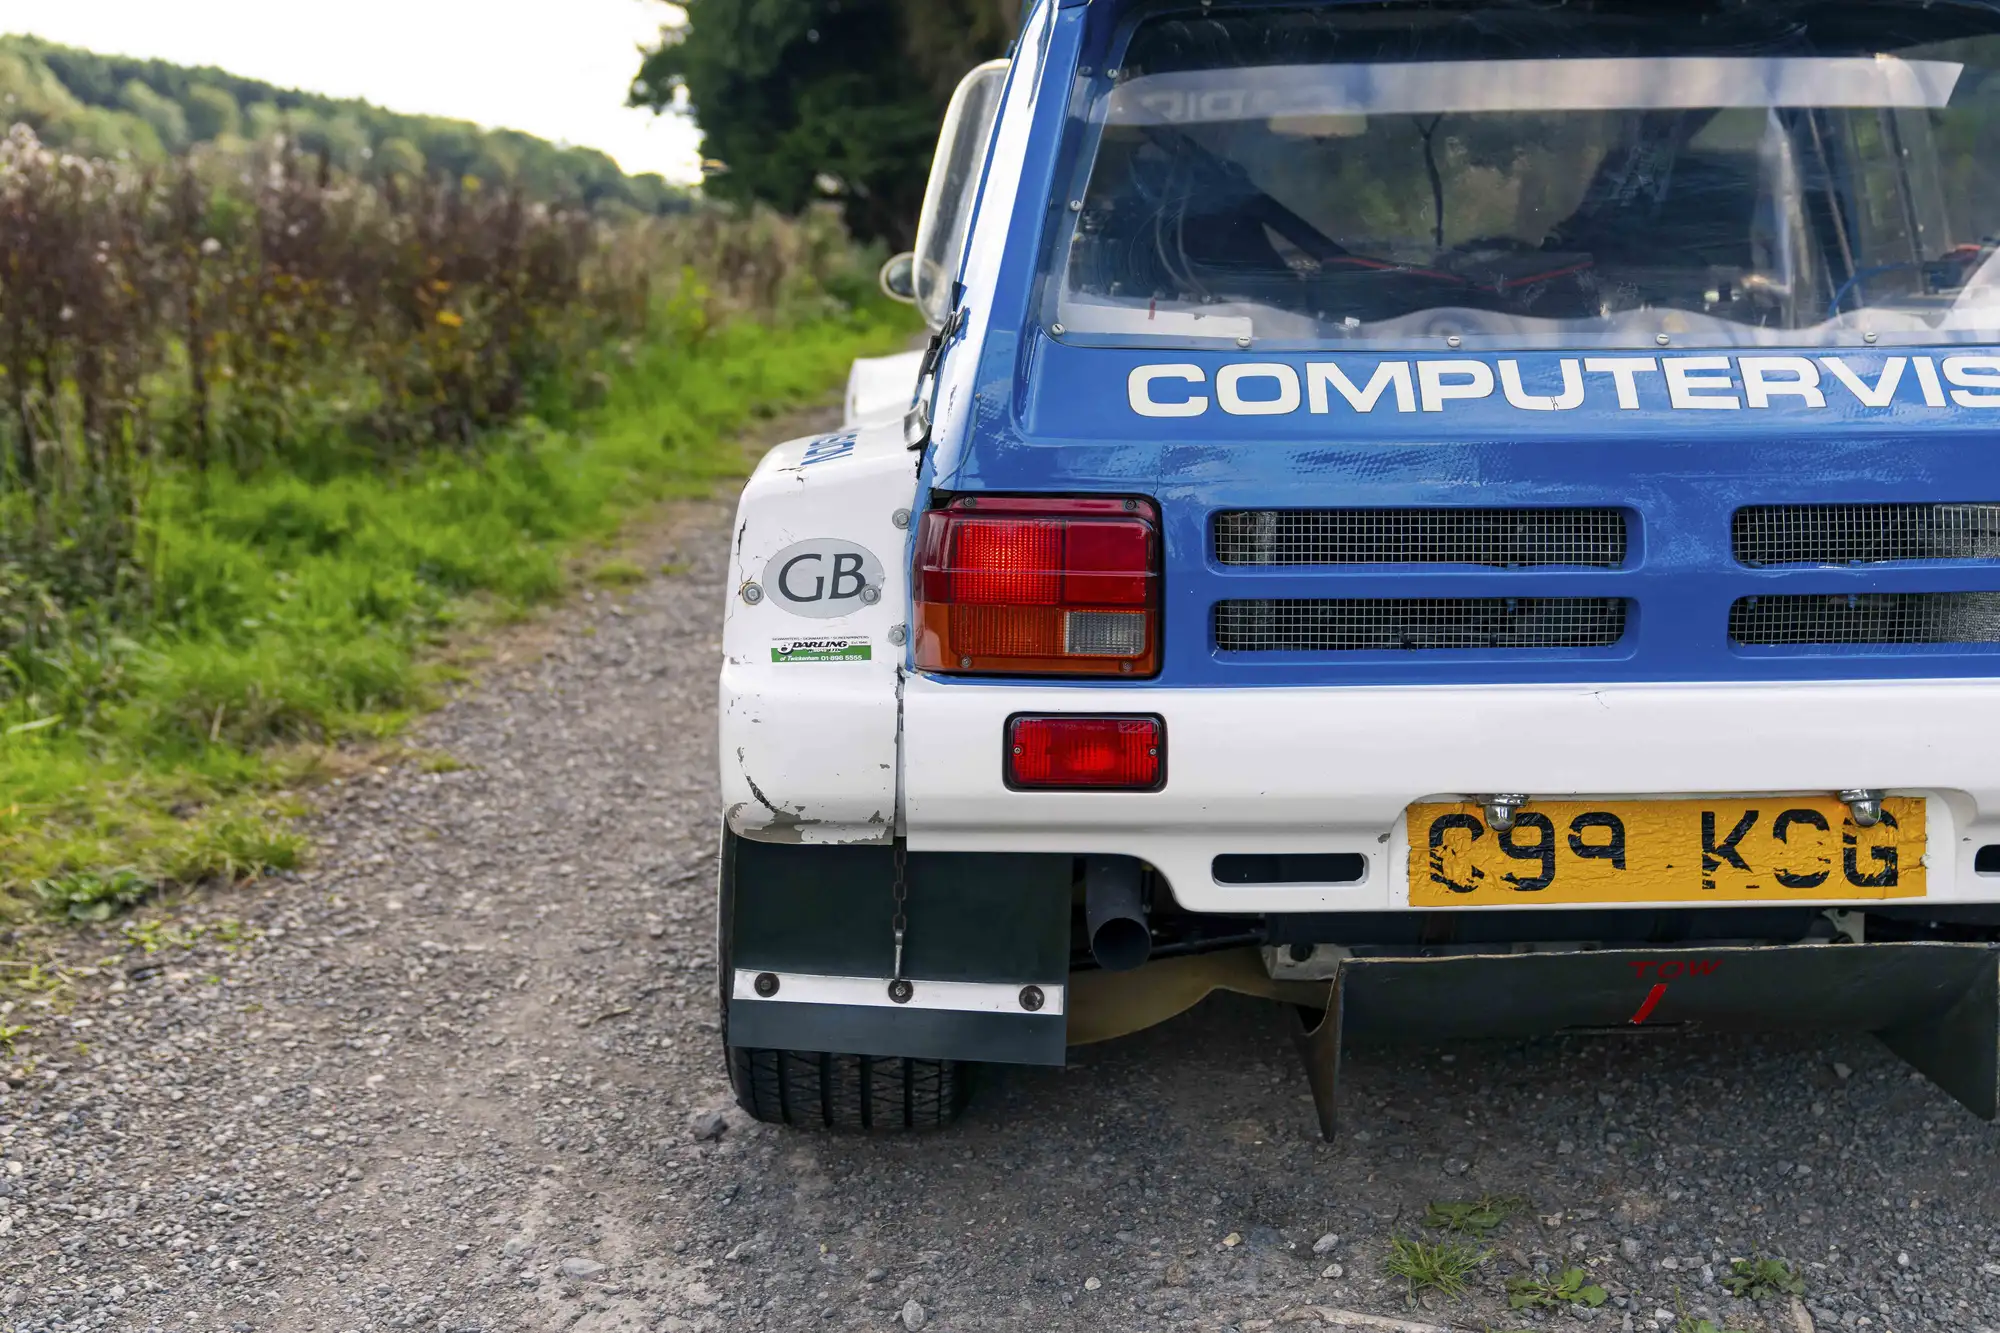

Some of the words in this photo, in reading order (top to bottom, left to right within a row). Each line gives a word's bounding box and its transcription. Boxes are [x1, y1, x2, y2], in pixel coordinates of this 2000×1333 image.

[778, 553, 866, 602] GB
[1429, 812, 1625, 893] C99
[1627, 959, 1724, 979] TOW
